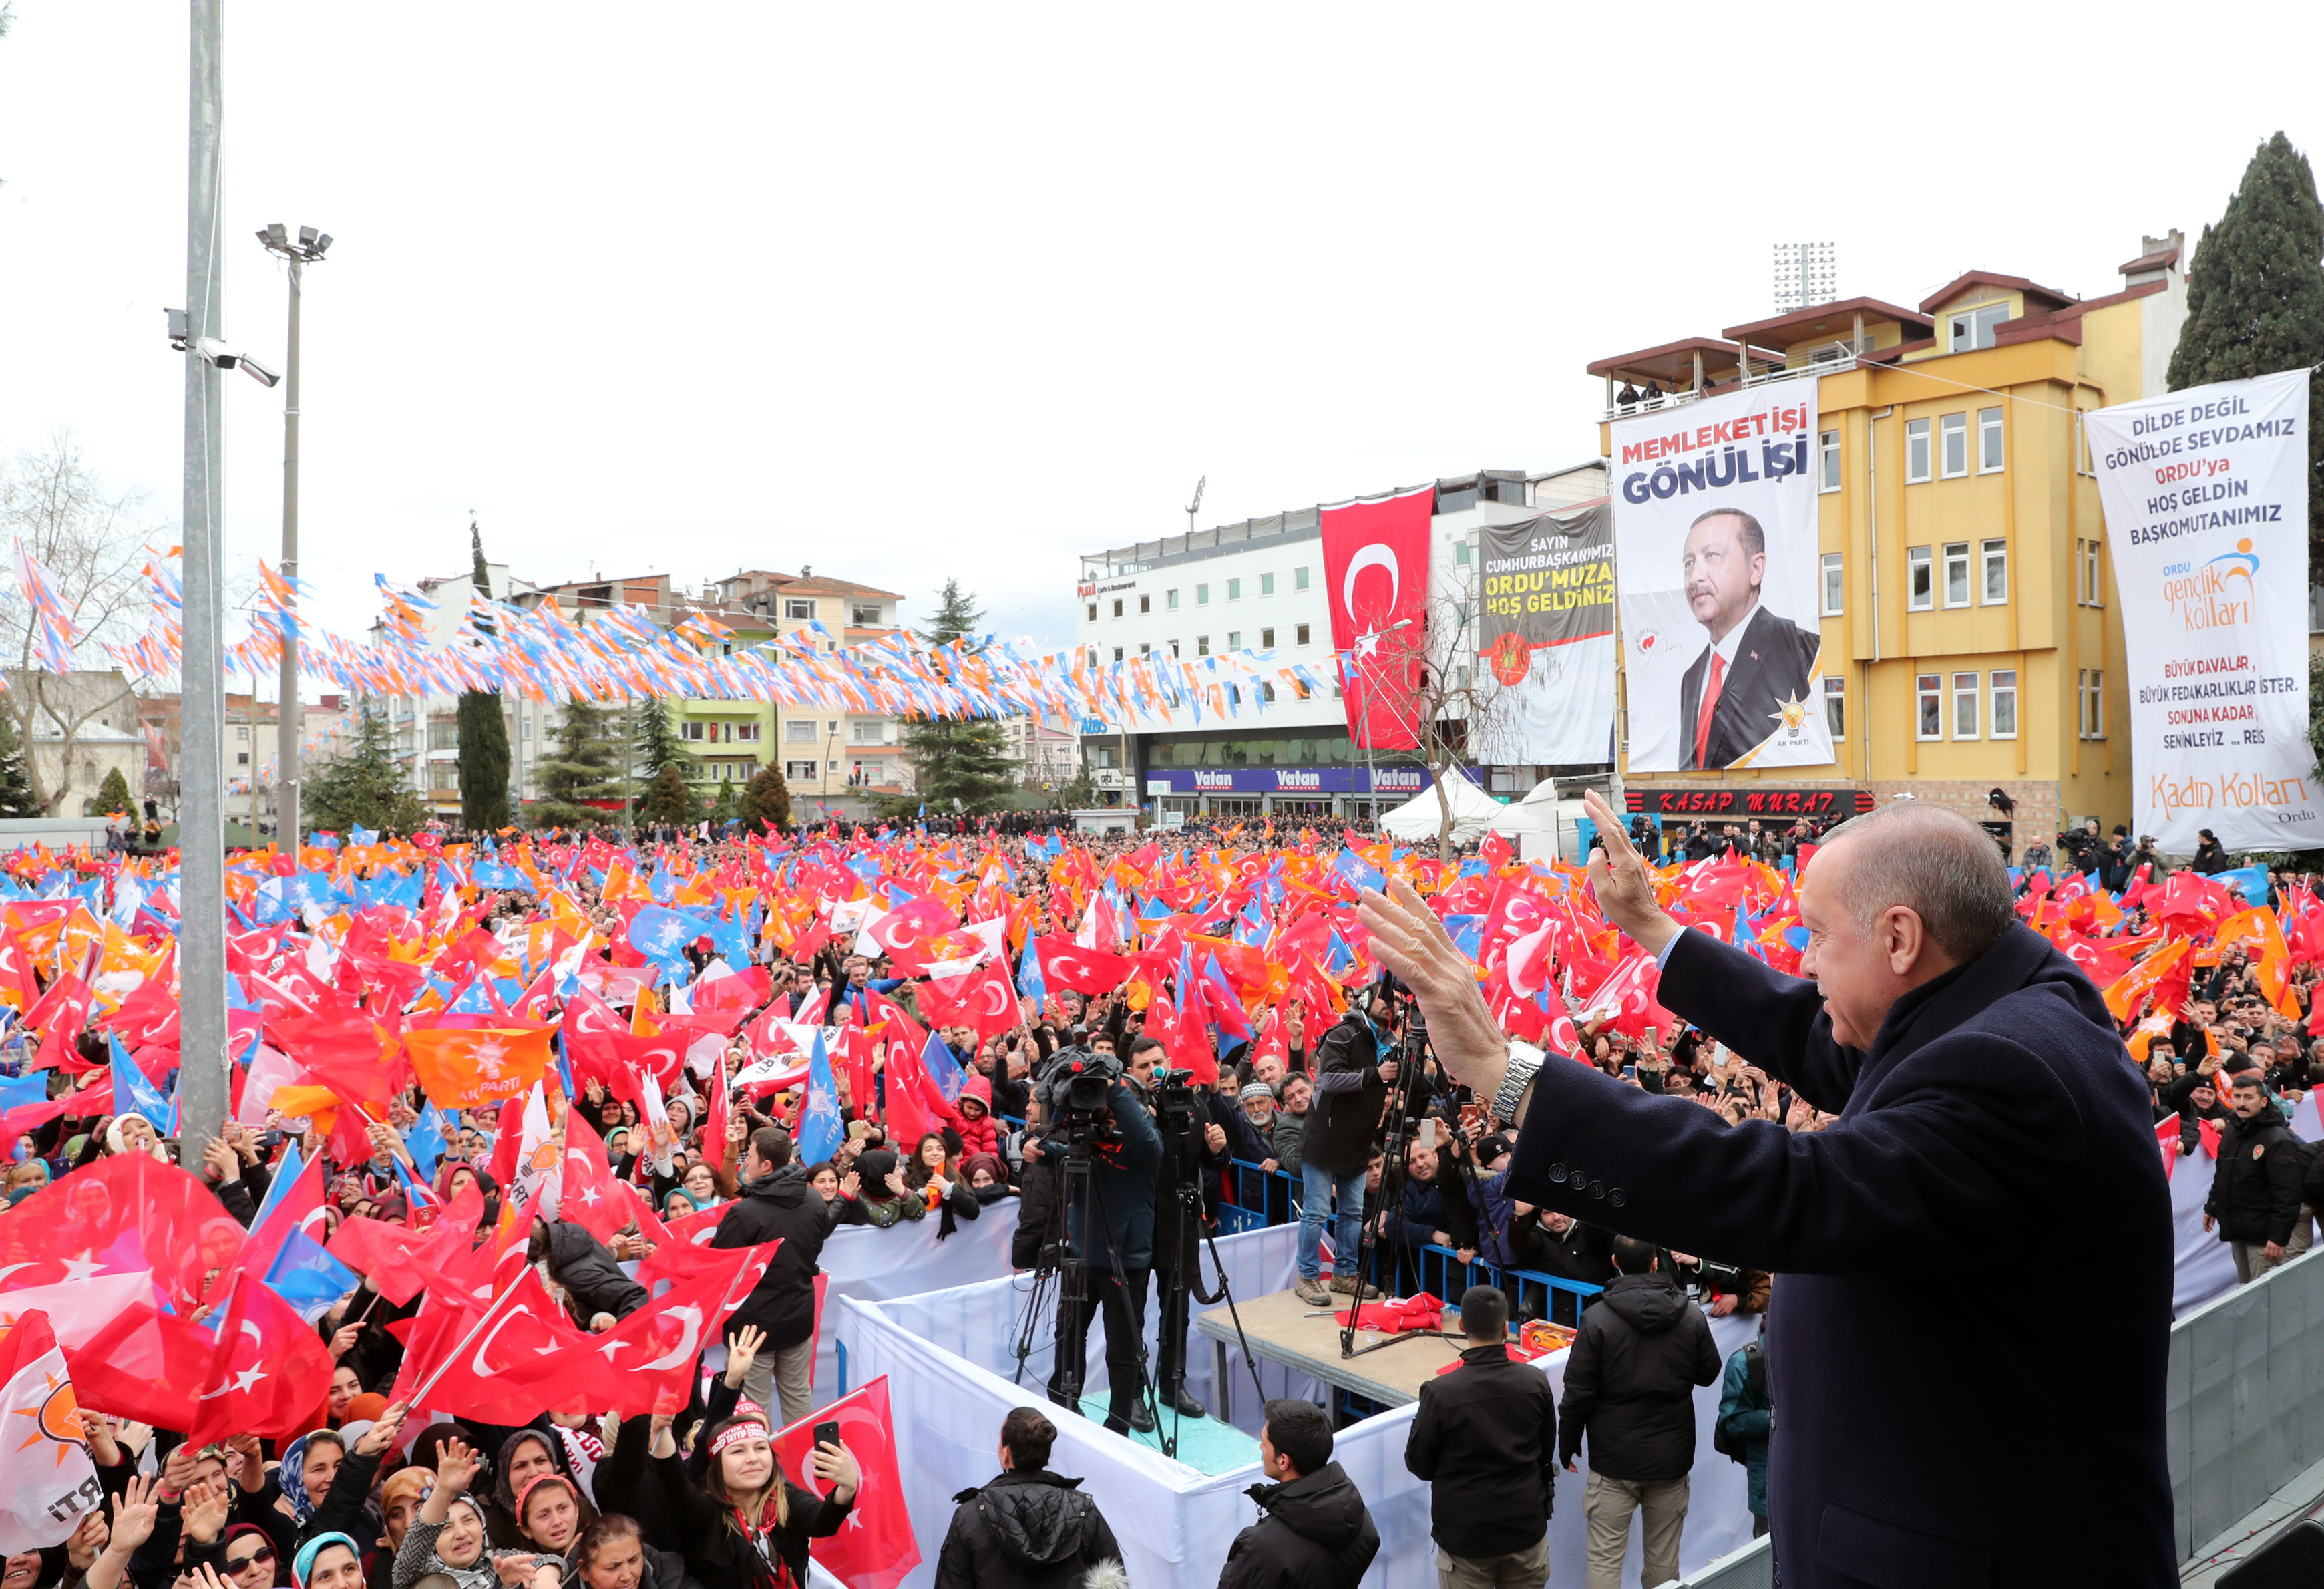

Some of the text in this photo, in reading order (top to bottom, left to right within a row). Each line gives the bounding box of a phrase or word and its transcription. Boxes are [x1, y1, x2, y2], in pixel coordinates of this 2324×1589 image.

[2132, 396, 2250, 437] DİLDE DEĞİL
[1622, 402, 1807, 465] MEMLEKET İŞİ
[2105, 418, 2295, 470] GÖNÜLDE SEVDAMIZ
[1623, 433, 1808, 504] GÖNÜL İŞİ
[2155, 458, 2230, 485] ORDU'ya
[2147, 478, 2249, 515] HOŞ GELDİN
[2130, 504, 2283, 545] BAŞKOMUTANIMIZ
[1485, 543, 1613, 573] CUMHURBAŞKANIMIZ
[1531, 535, 1569, 552] SAYIN
[1485, 562, 1613, 596] ORDU'MUZA
[2163, 562, 2191, 576] ORDU
[1487, 584, 1614, 619] HOŞ GELDİNİZ
[2164, 565, 2224, 614] gençlik
[2184, 596, 2249, 631] kolları
[2164, 658, 2196, 679] BÜYÜK
[2140, 675, 2299, 704] BÜYÜK FEDAKARLIKLAR İSTER.
[2168, 708, 2209, 725] SONUNA
[2164, 731, 2224, 749] SENİNLEYİZ
[2243, 727, 2266, 745] REİS
[1194, 770, 1233, 786] Vatan
[1276, 769, 1320, 786] Vatan
[1372, 769, 1421, 786] Vatan
[1659, 791, 1835, 812] KASAP MURAT
[2152, 773, 2308, 822] Kadın Kolları
[2279, 810, 2316, 824] Ordu
[458, 1087, 480, 1101] AK
